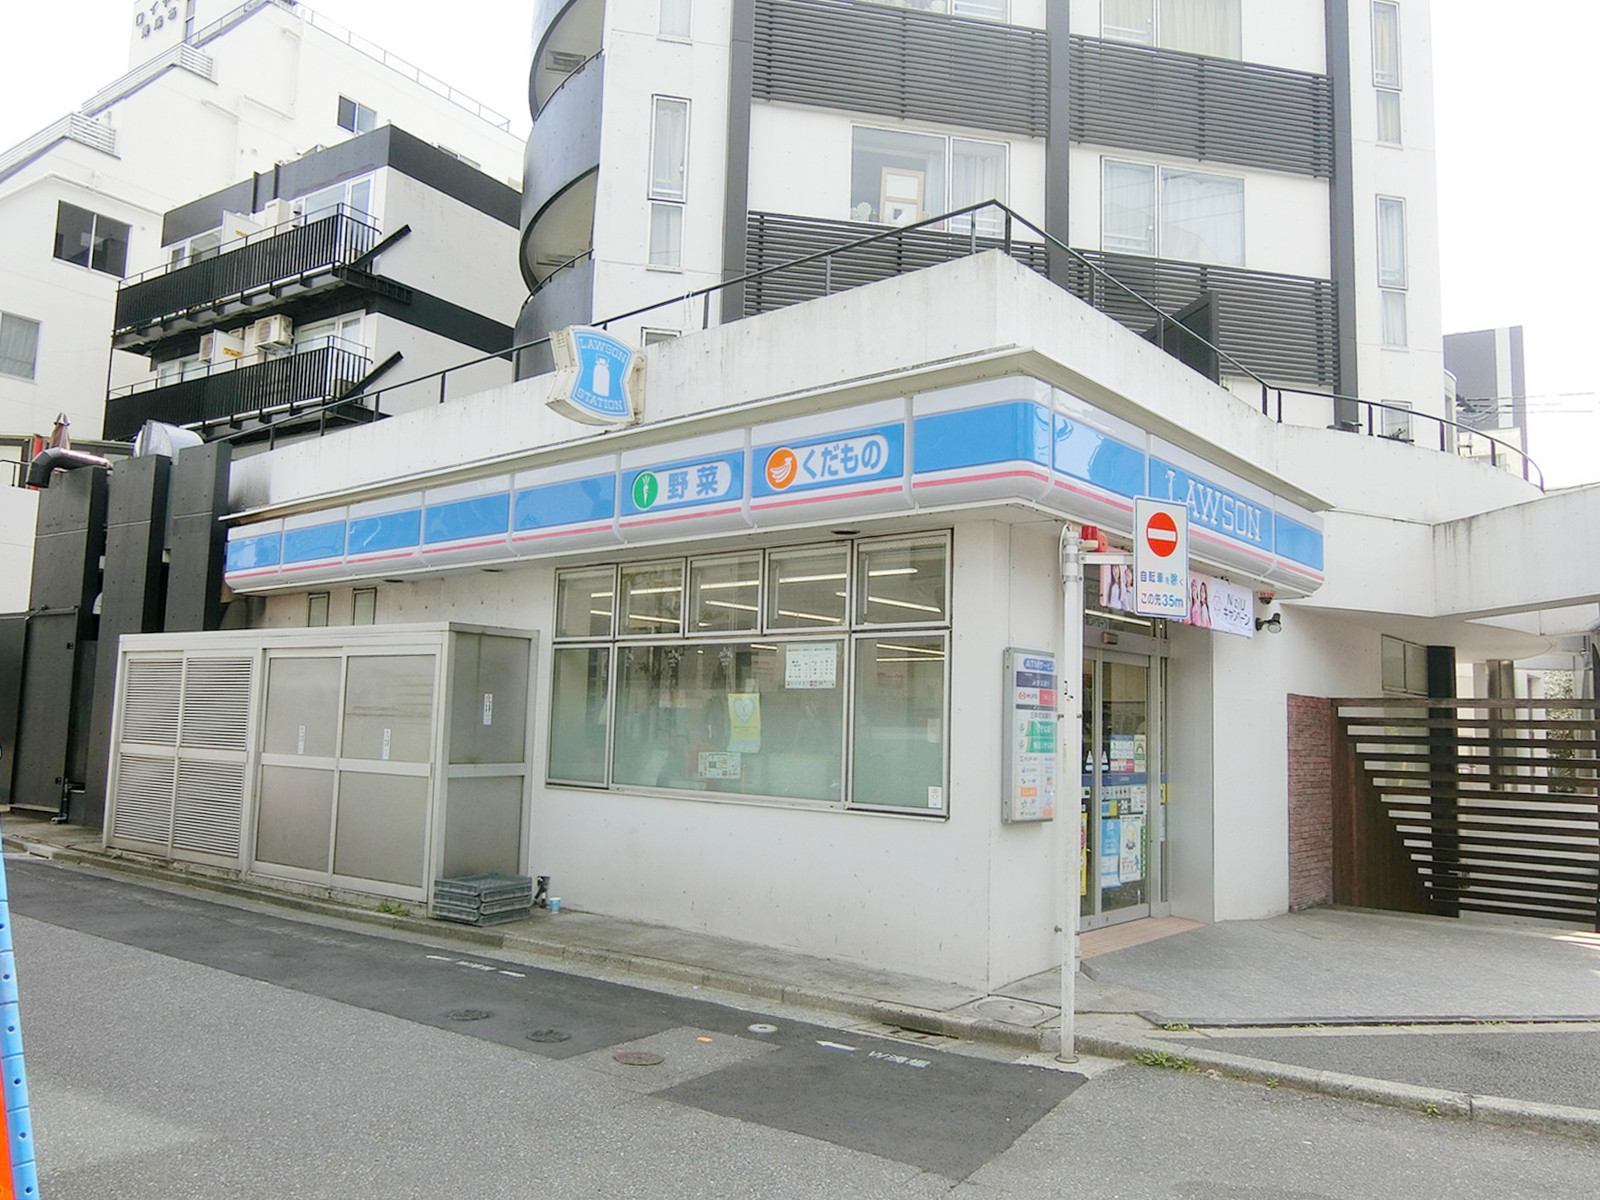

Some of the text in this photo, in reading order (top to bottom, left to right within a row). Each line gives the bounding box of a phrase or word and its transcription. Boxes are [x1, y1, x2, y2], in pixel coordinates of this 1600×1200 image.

[580, 338, 627, 363] LAWSON
[577, 387, 623, 410] STATION
[802, 439, 882, 480] くだもの
[668, 465, 718, 500] 野菜
[1166, 469, 1262, 542] LAWSON
[1140, 571, 1184, 586] 自転車を除く
[1141, 593, 1184, 608] この先35m
